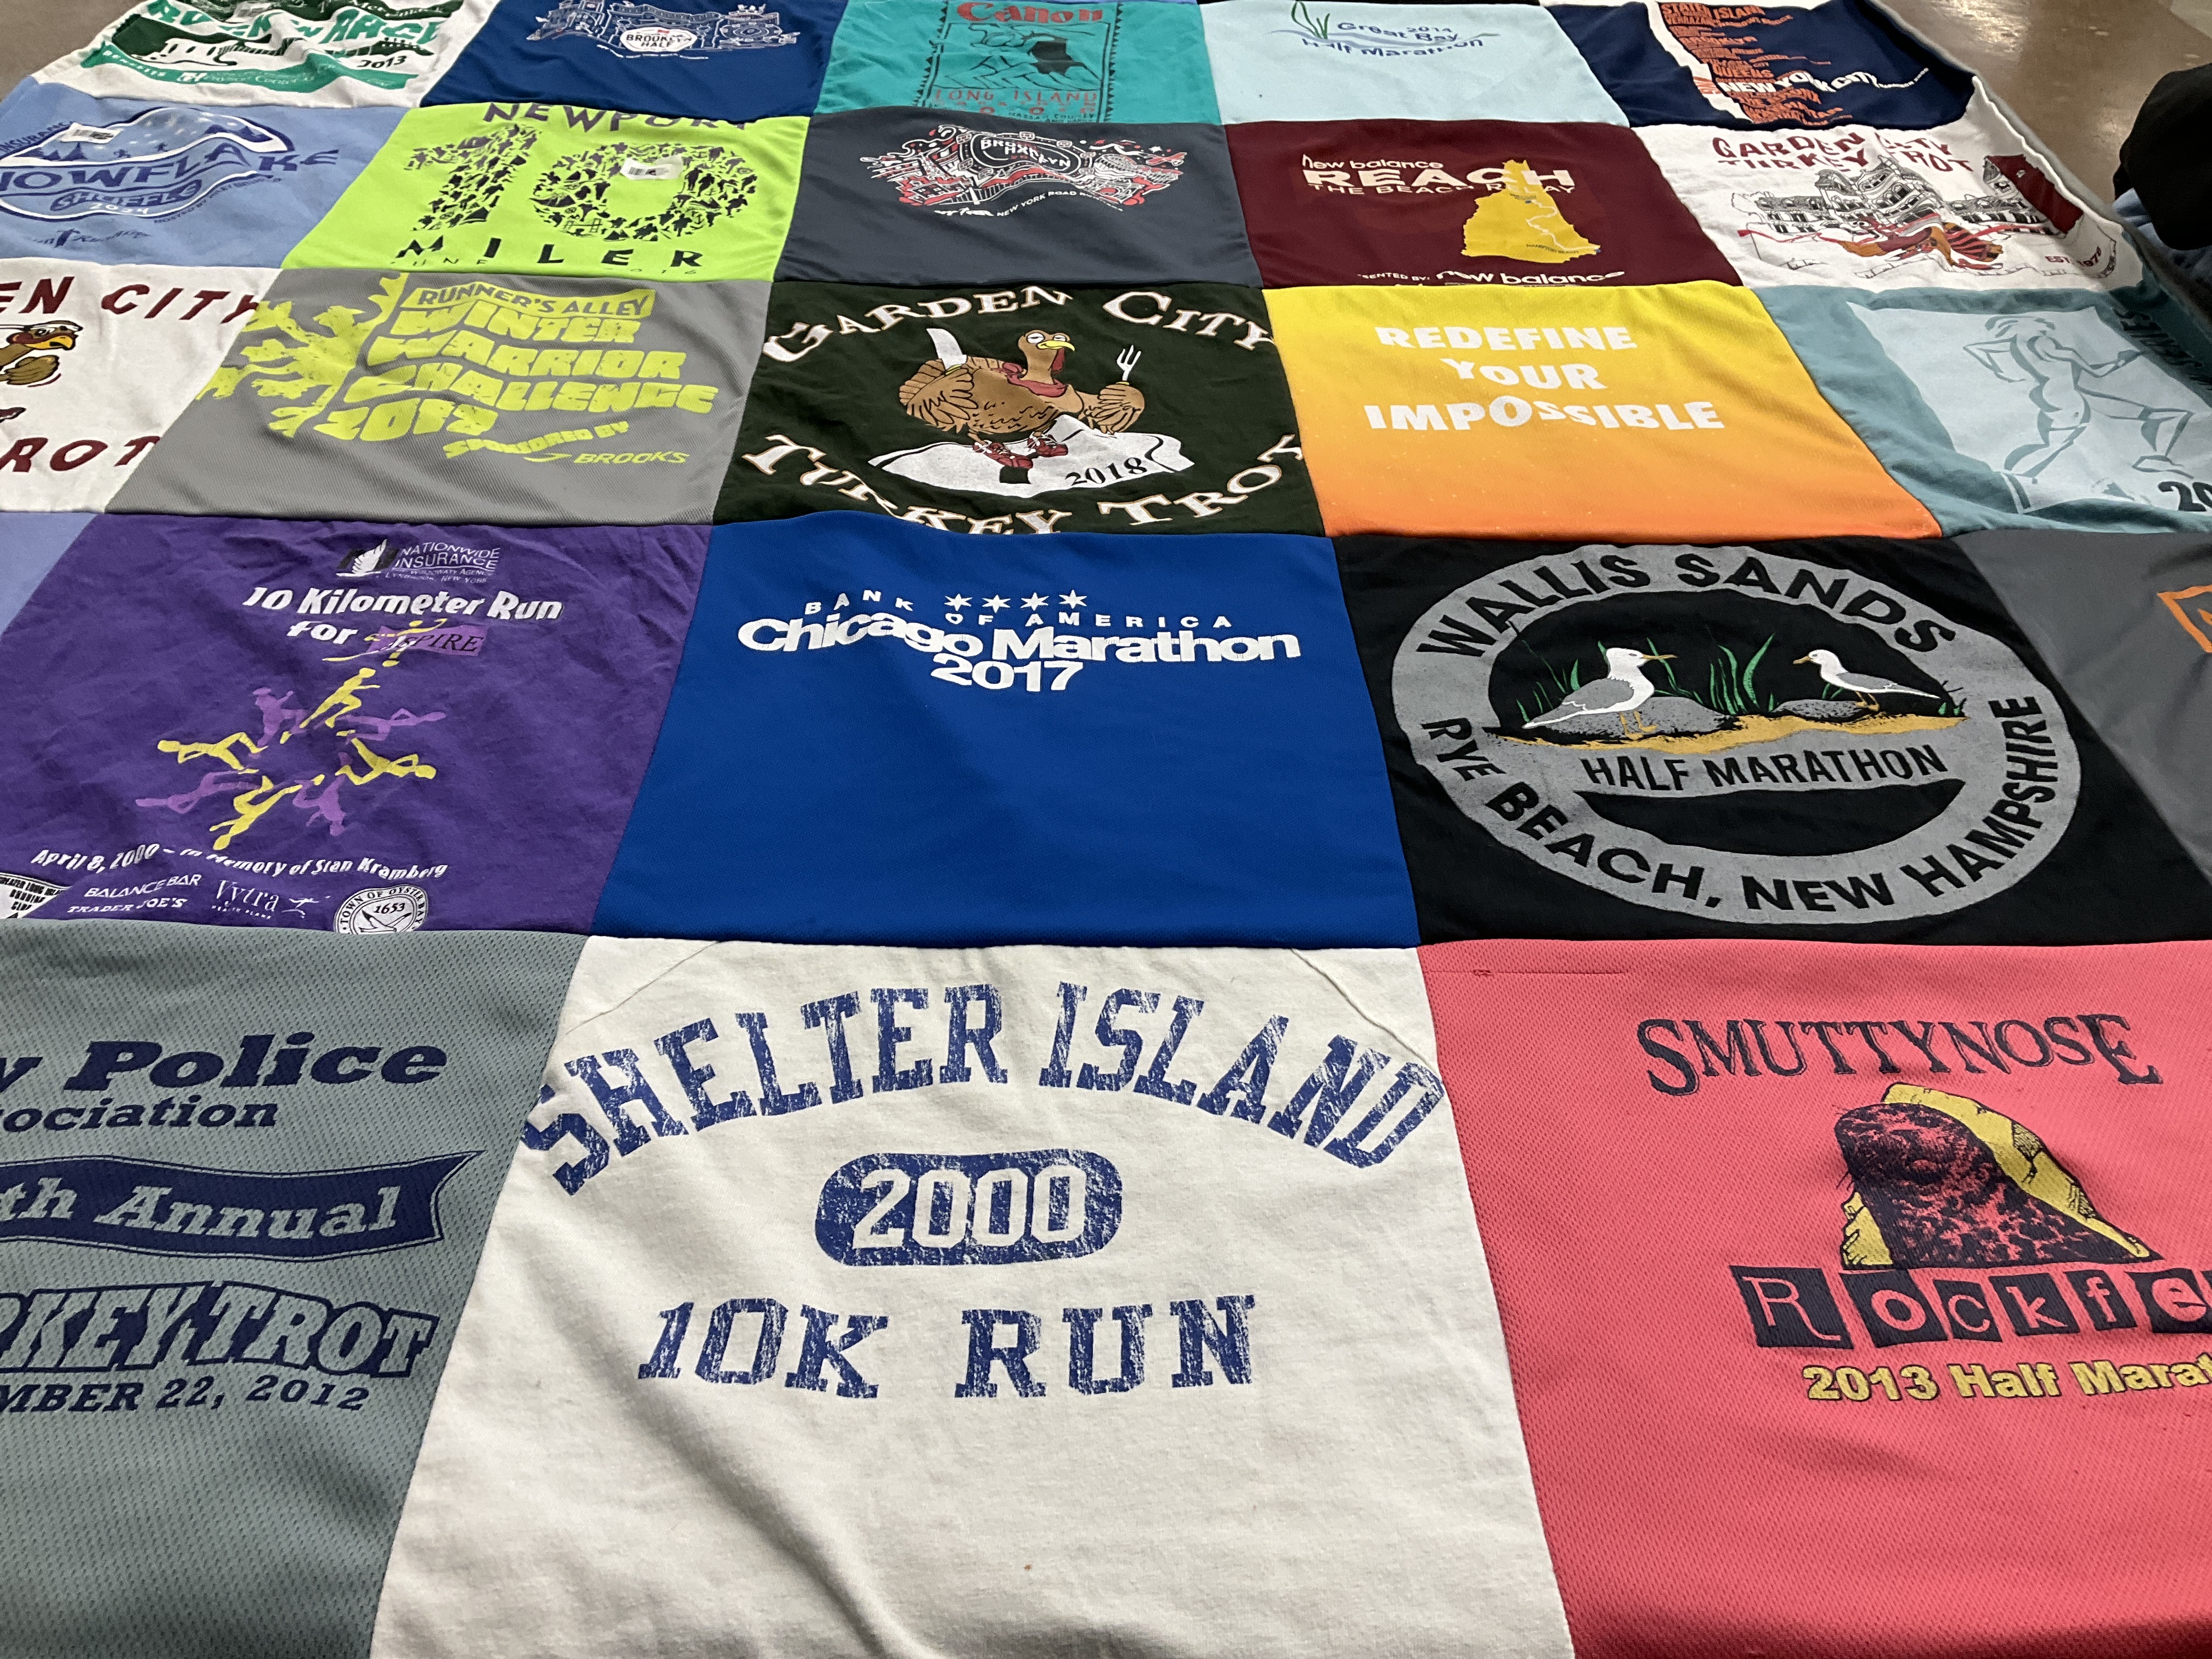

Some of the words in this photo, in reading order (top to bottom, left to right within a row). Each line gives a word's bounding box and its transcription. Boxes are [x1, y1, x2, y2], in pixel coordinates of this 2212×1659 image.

[957, 2, 1103, 23] Canon
[626, 34, 692, 43] BROOKLYN
[1337, 22, 1407, 38] Great
[1415, 33, 1458, 42] Bay
[357, 55, 407, 68] 2013
[934, 89, 994, 101] LONG
[1014, 92, 1097, 103] ISLAND
[1717, 82, 1776, 93] NEW
[1302, 154, 1344, 168] new
[1350, 159, 1443, 169] balance
[1712, 132, 1865, 157] GARDEN
[1718, 149, 1869, 172] TURKEY
[1302, 168, 1575, 187] REACH
[1308, 184, 1364, 194] THE
[997, 205, 1018, 216] NEW
[1021, 194, 1046, 207] YORK
[395, 236, 703, 268] MILER
[101, 284, 259, 324] CITY
[419, 285, 555, 313] RUNNER'S
[560, 295, 650, 317] ALLEY
[391, 300, 641, 343] WINTER
[761, 286, 1073, 364] GARDEN
[1102, 291, 1277, 352] CITY
[1374, 326, 1638, 351] REDEFINE
[367, 330, 686, 379] WARRIOR
[343, 363, 718, 414] CHALLENGE
[1440, 358, 1608, 390] YOUR
[1364, 395, 1725, 431] IMPOSSIBLE
[443, 428, 594, 459] SPONSORED
[595, 421, 629, 439] BY
[573, 451, 690, 464] BROOKS
[743, 435, 1074, 535] TURKEY
[1098, 435, 1305, 529] TROT
[1065, 457, 1150, 488] 2018
[394, 553, 499, 569] INSURANCE
[401, 541, 500, 558] NATIONWIDE
[243, 586, 294, 611] 10
[297, 588, 485, 616] Kilometer
[487, 590, 564, 621] Run
[805, 589, 915, 614] BANK
[945, 612, 994, 627] OF
[1025, 612, 1234, 628] AMERICA
[1418, 554, 1652, 658] WALLIS
[1678, 554, 1957, 652] SANDS
[738, 612, 984, 659] Chicago
[992, 626, 1302, 663] Marathon
[931, 652, 1085, 693] 2017
[1581, 755, 1691, 792] HALF
[1706, 744, 1948, 787] MARATHON
[1421, 717, 1500, 783] RYE
[1485, 781, 1723, 909] BEACH,
[1743, 872, 1895, 912] NEW
[1899, 695, 2059, 898] HAMPSHIRE
[31, 849, 88, 871] April
[87, 855, 106, 874] 8,
[109, 843, 160, 870] 2000
[289, 859, 314, 876] of
[311, 859, 354, 876] Stan
[84, 879, 166, 898] BALANCE
[166, 874, 202, 887] BAR
[215, 879, 280, 912] Vytra
[67, 904, 134, 913] TRADER
[136, 897, 188, 909] JOE'S
[340, 895, 364, 924] TOWN
[367, 890, 383, 899] OF
[389, 887, 424, 901] OYSTER
[415, 901, 426, 924] BAY
[373, 902, 406, 915] 1653
[64, 1031, 448, 1091] Police
[1637, 1012, 2165, 1098] SMUTTYNOSE
[519, 982, 1010, 1198] SHELTER
[1039, 980, 1446, 1171] ISLAND
[0, 1093, 279, 1134] ociation
[93, 1184, 403, 1240] Annual
[853, 1167, 1094, 1251] 2000
[1739, 1268, 2212, 1347] Rockfe
[187, 1280, 441, 1378] TROT
[636, 1297, 891, 1400] 10K
[953, 1294, 1257, 1399] RUN
[158, 1375, 223, 1412] 22,
[246, 1374, 370, 1412] 2012
[1802, 1363, 1941, 1404] 2013
[1947, 1361, 2064, 1401] Half
